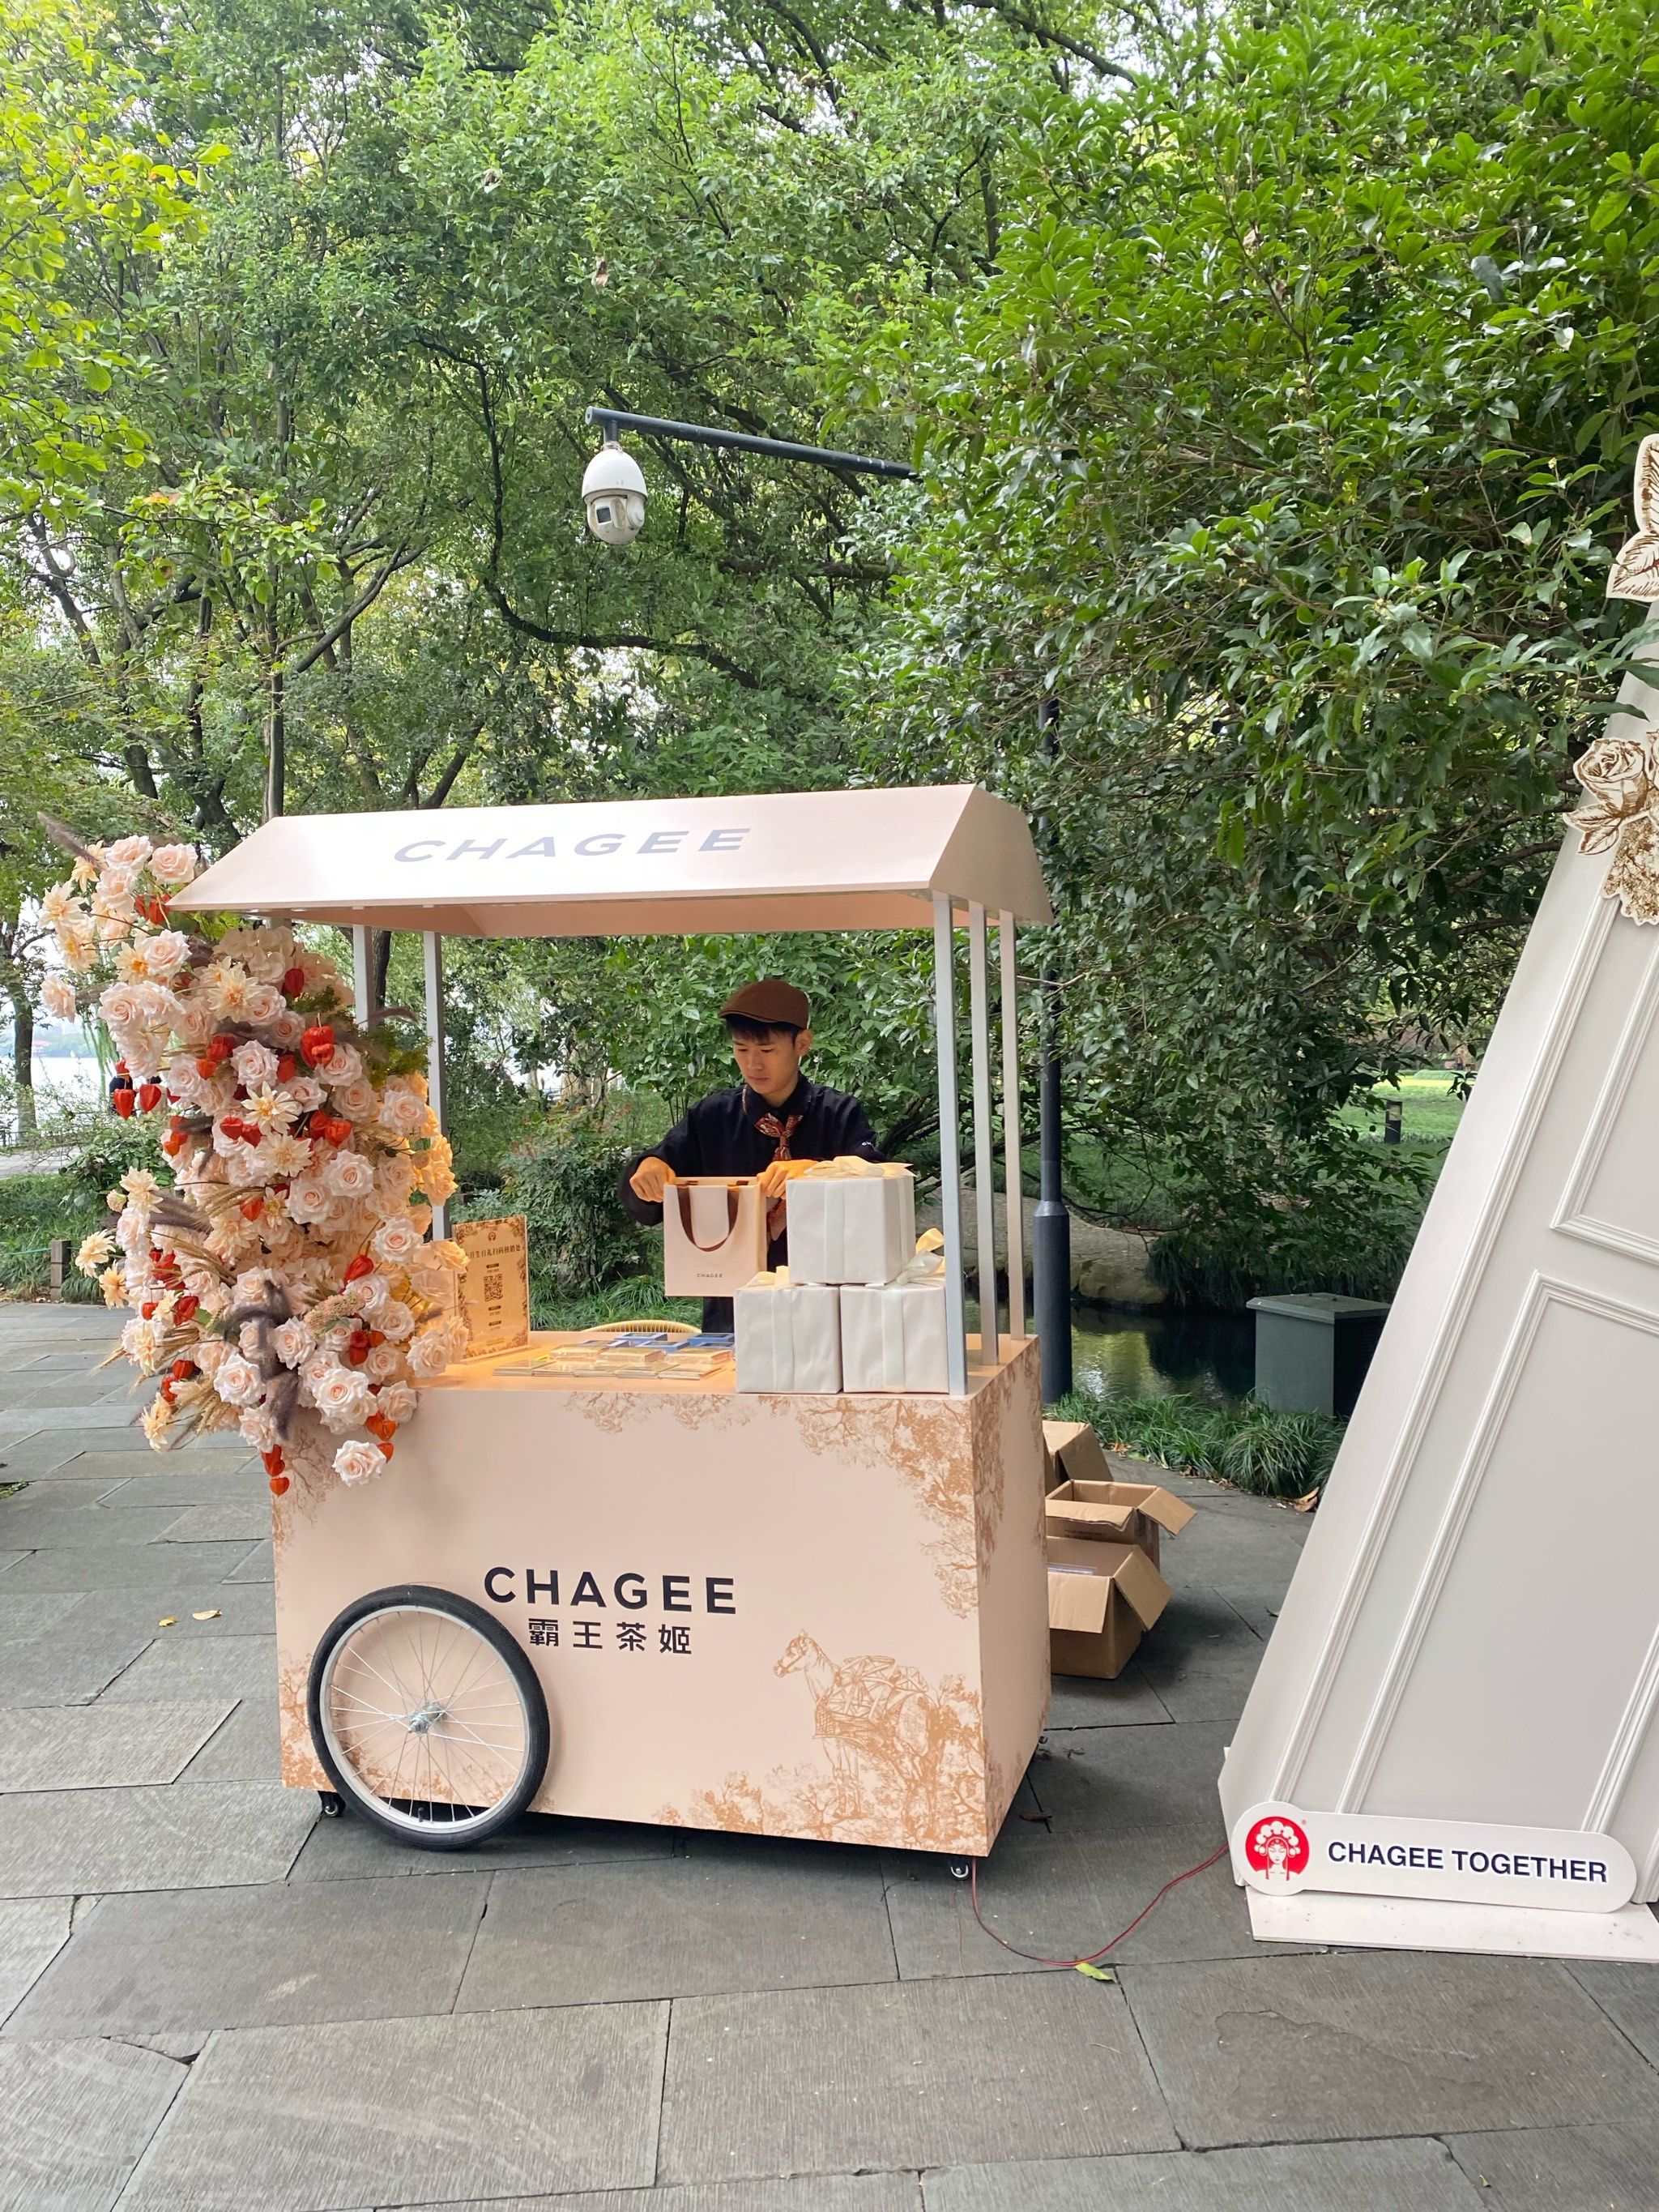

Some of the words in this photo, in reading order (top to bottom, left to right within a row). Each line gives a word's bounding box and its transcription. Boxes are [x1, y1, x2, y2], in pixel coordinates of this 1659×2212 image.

[394, 827, 752, 863] CHAGEE
[484, 1566, 736, 1615] CHAGEE
[528, 1617, 692, 1655] 霸王茶姬
[1328, 1841, 1444, 1871] CHAGEE
[1451, 1849, 1608, 1884] TOGETHER
